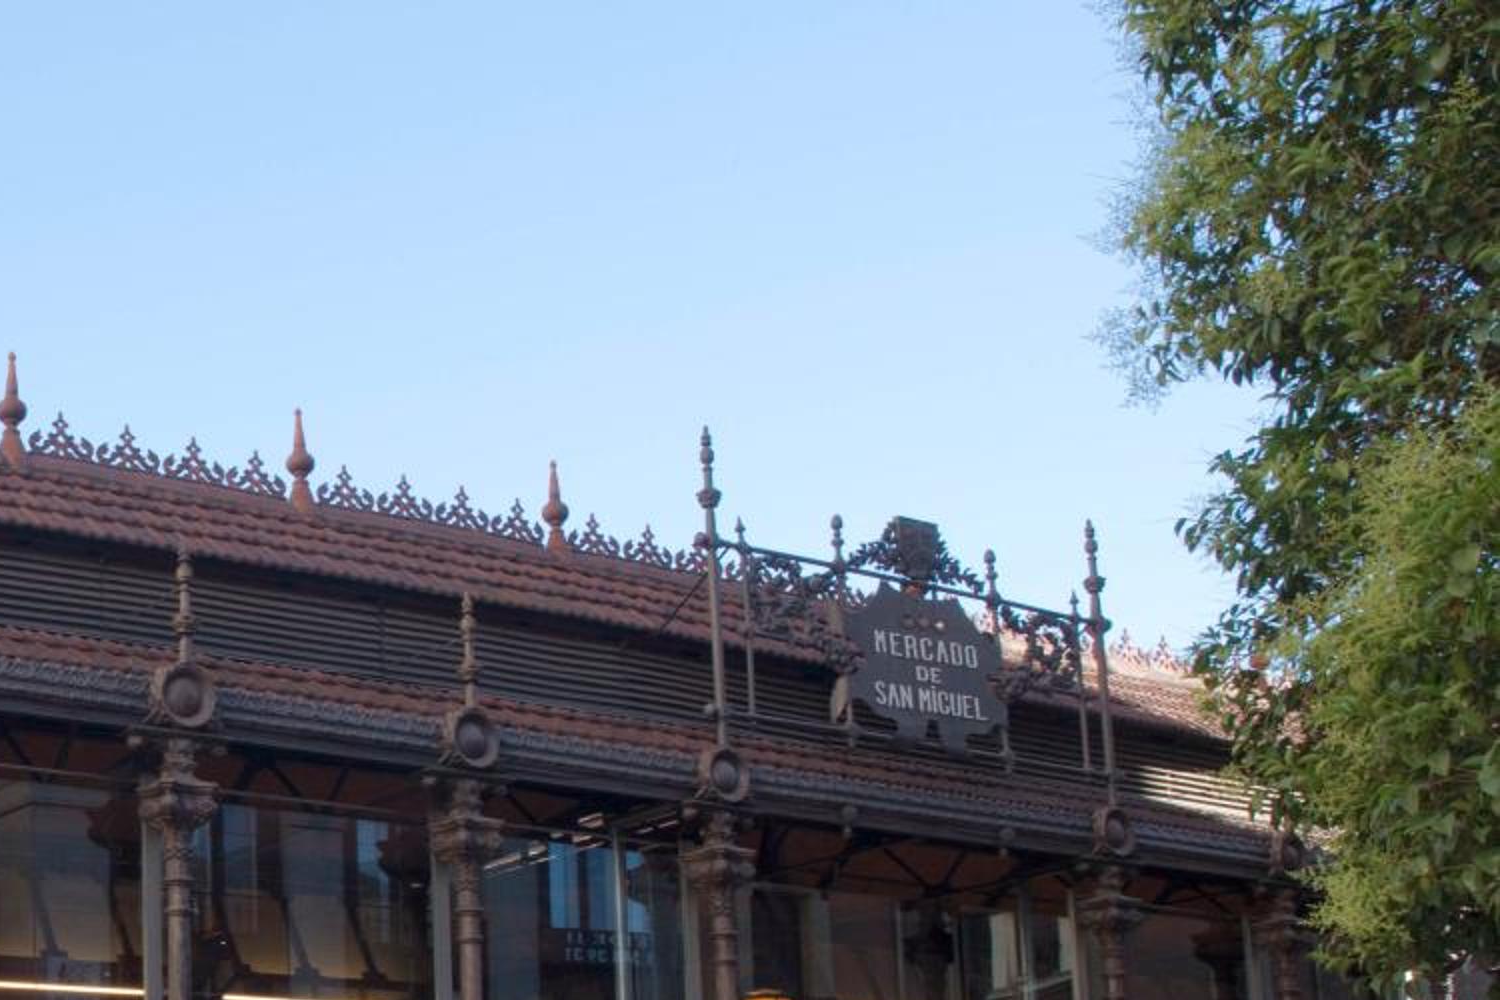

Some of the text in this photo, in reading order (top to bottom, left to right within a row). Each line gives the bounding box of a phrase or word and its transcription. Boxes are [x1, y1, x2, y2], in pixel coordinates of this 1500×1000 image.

[874, 629, 979, 668] MERCADO
[915, 666, 942, 685] DE
[875, 680, 914, 709] SAN
